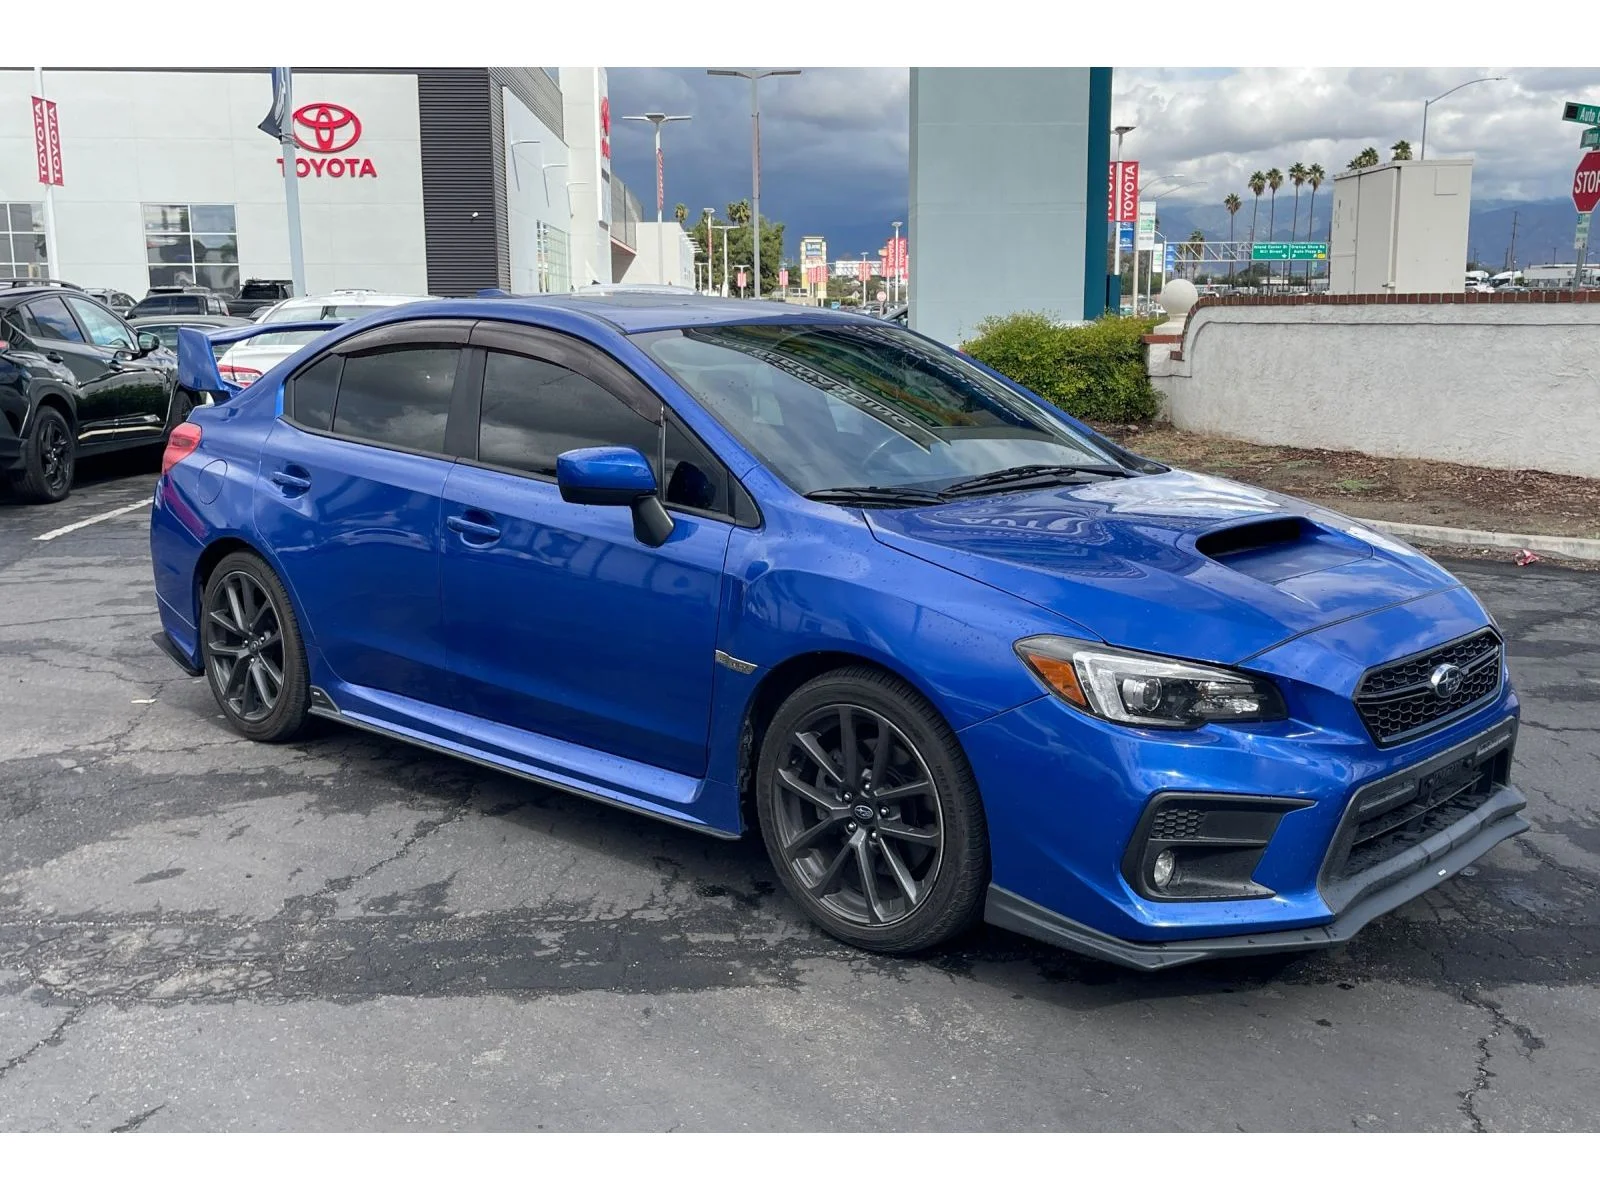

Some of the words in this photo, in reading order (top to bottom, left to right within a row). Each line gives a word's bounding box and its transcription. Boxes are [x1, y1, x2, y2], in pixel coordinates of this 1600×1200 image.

[35, 102, 48, 178] TOYOTA
[49, 107, 61, 181] TOYOTA
[1580, 107, 1596, 122] Auto
[1123, 164, 1136, 219] TOYOTA
